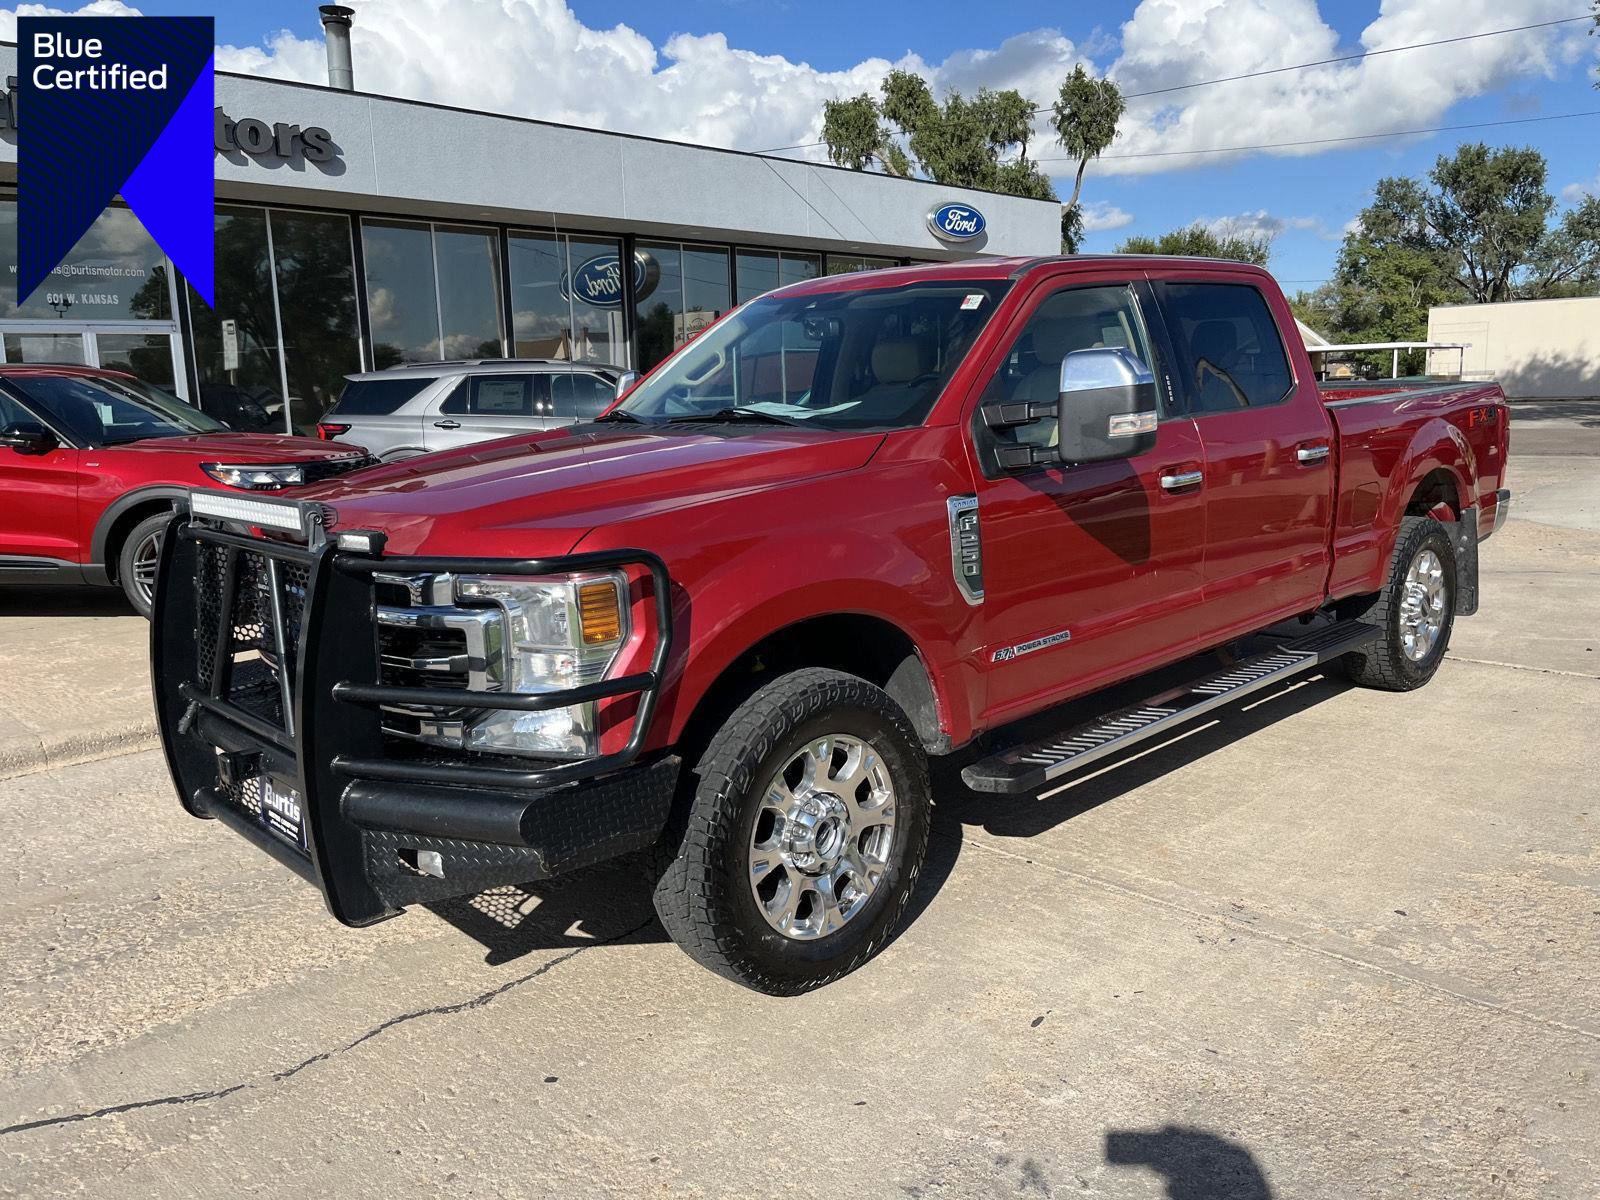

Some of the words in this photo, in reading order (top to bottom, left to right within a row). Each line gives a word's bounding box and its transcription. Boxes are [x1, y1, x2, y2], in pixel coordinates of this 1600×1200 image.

[214, 106, 332, 162] tors
[945, 209, 977, 233] Ford
[46, 293, 64, 304] 601
[66, 293, 79, 304] W.
[81, 294, 119, 305] KANSAS
[1469, 407, 1496, 429] FX4
[1017, 641, 1041, 654] POWER
[1042, 631, 1069, 646] STROKE
[264, 783, 301, 823] Burtis
